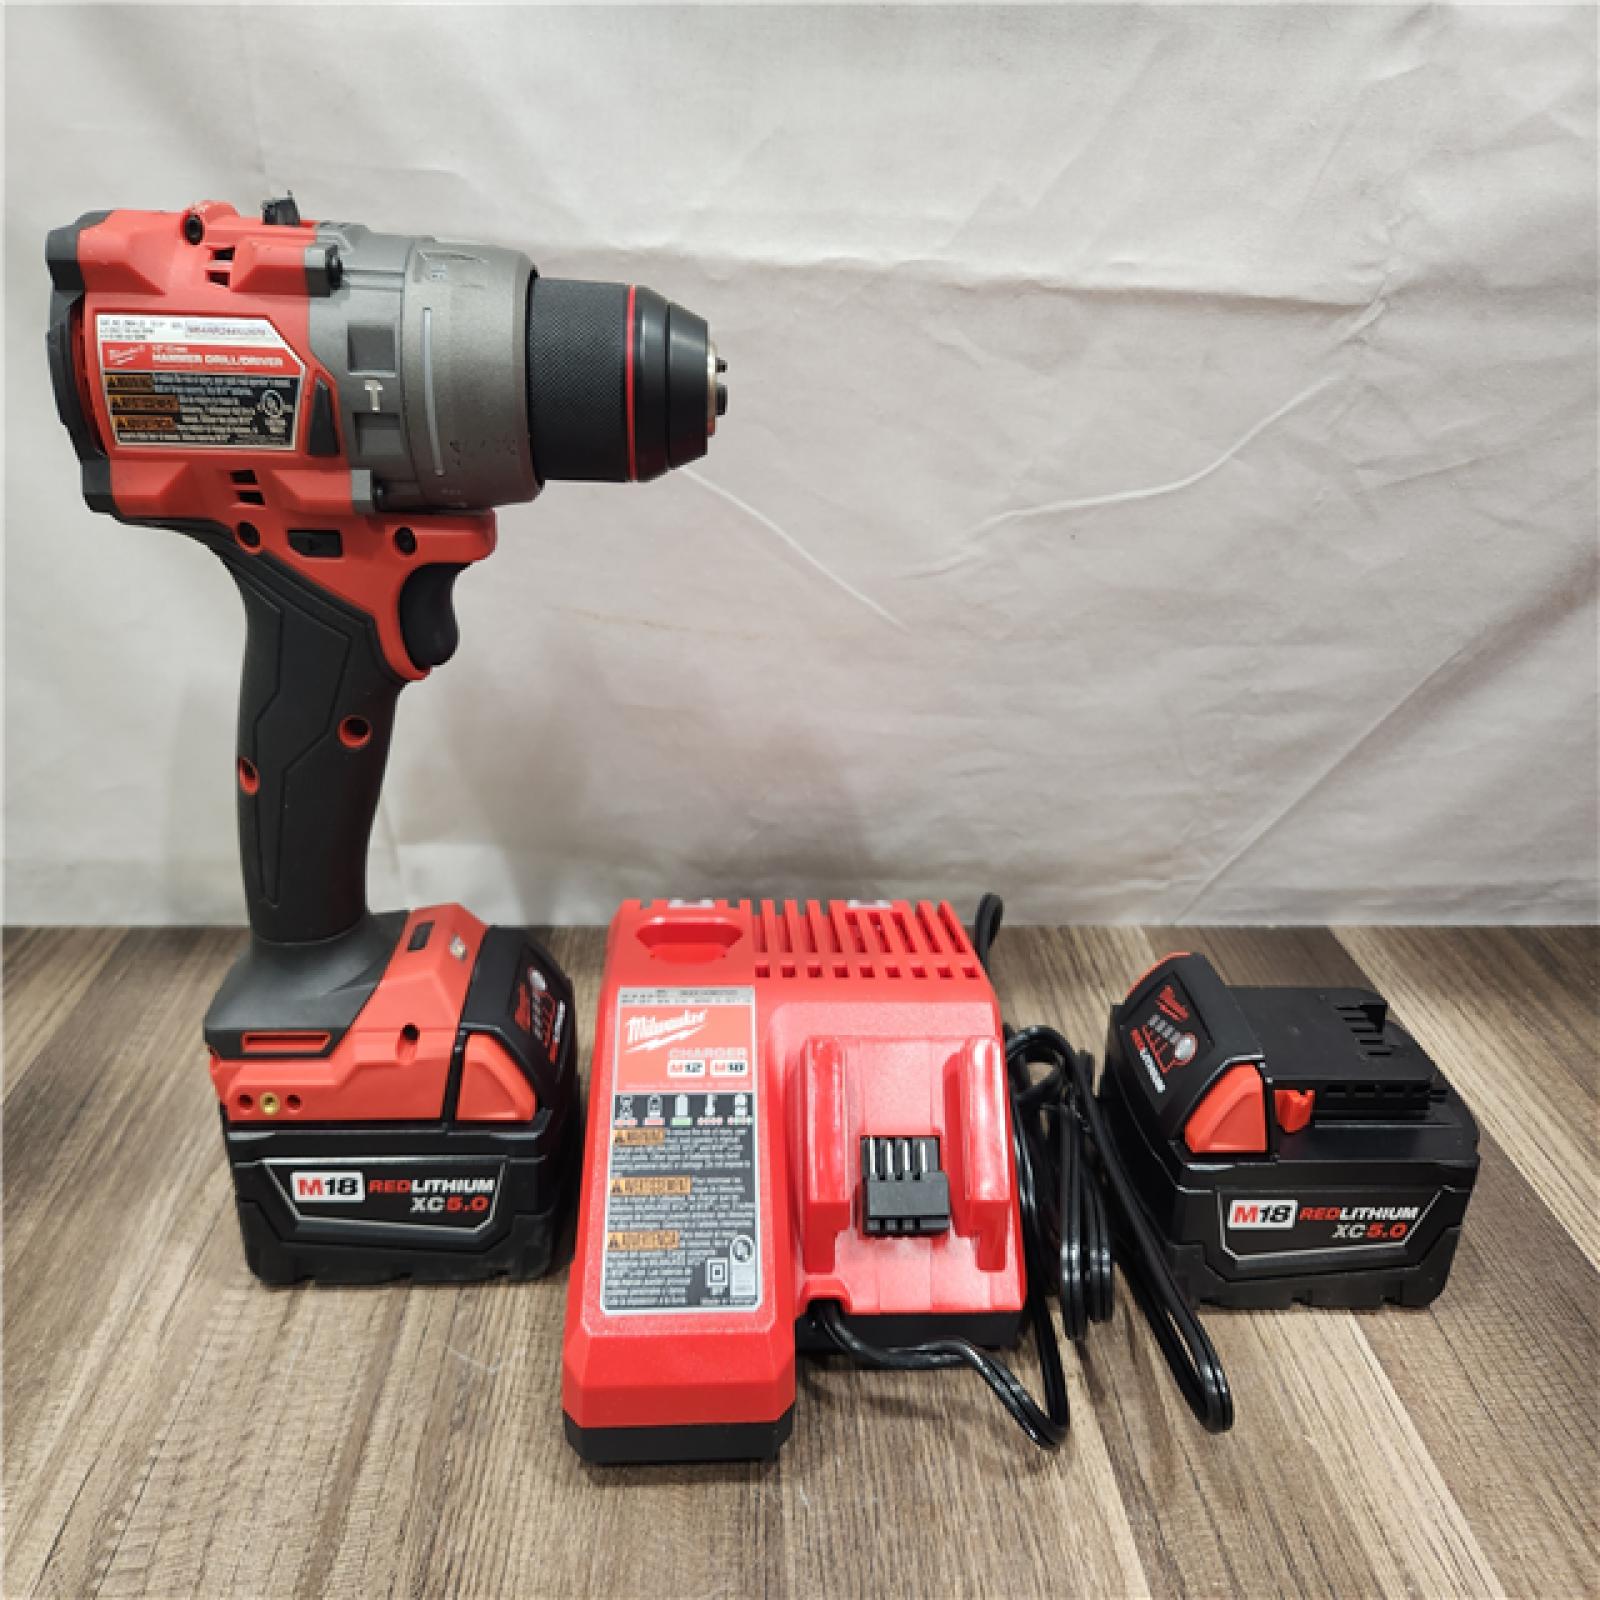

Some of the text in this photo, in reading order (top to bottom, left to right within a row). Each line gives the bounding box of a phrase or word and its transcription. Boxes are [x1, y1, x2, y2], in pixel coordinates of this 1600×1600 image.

[625, 1008, 707, 1046] Milwaukee
[669, 1047, 747, 1060] CHARGER
[671, 1062, 746, 1073] M12 M18
[297, 1177, 495, 1196] M18 REDLITHIUM
[410, 1196, 490, 1213] XC5.0
[1232, 1204, 1420, 1224] M18 REDLITHIUM
[1331, 1222, 1409, 1239] XC5.0
